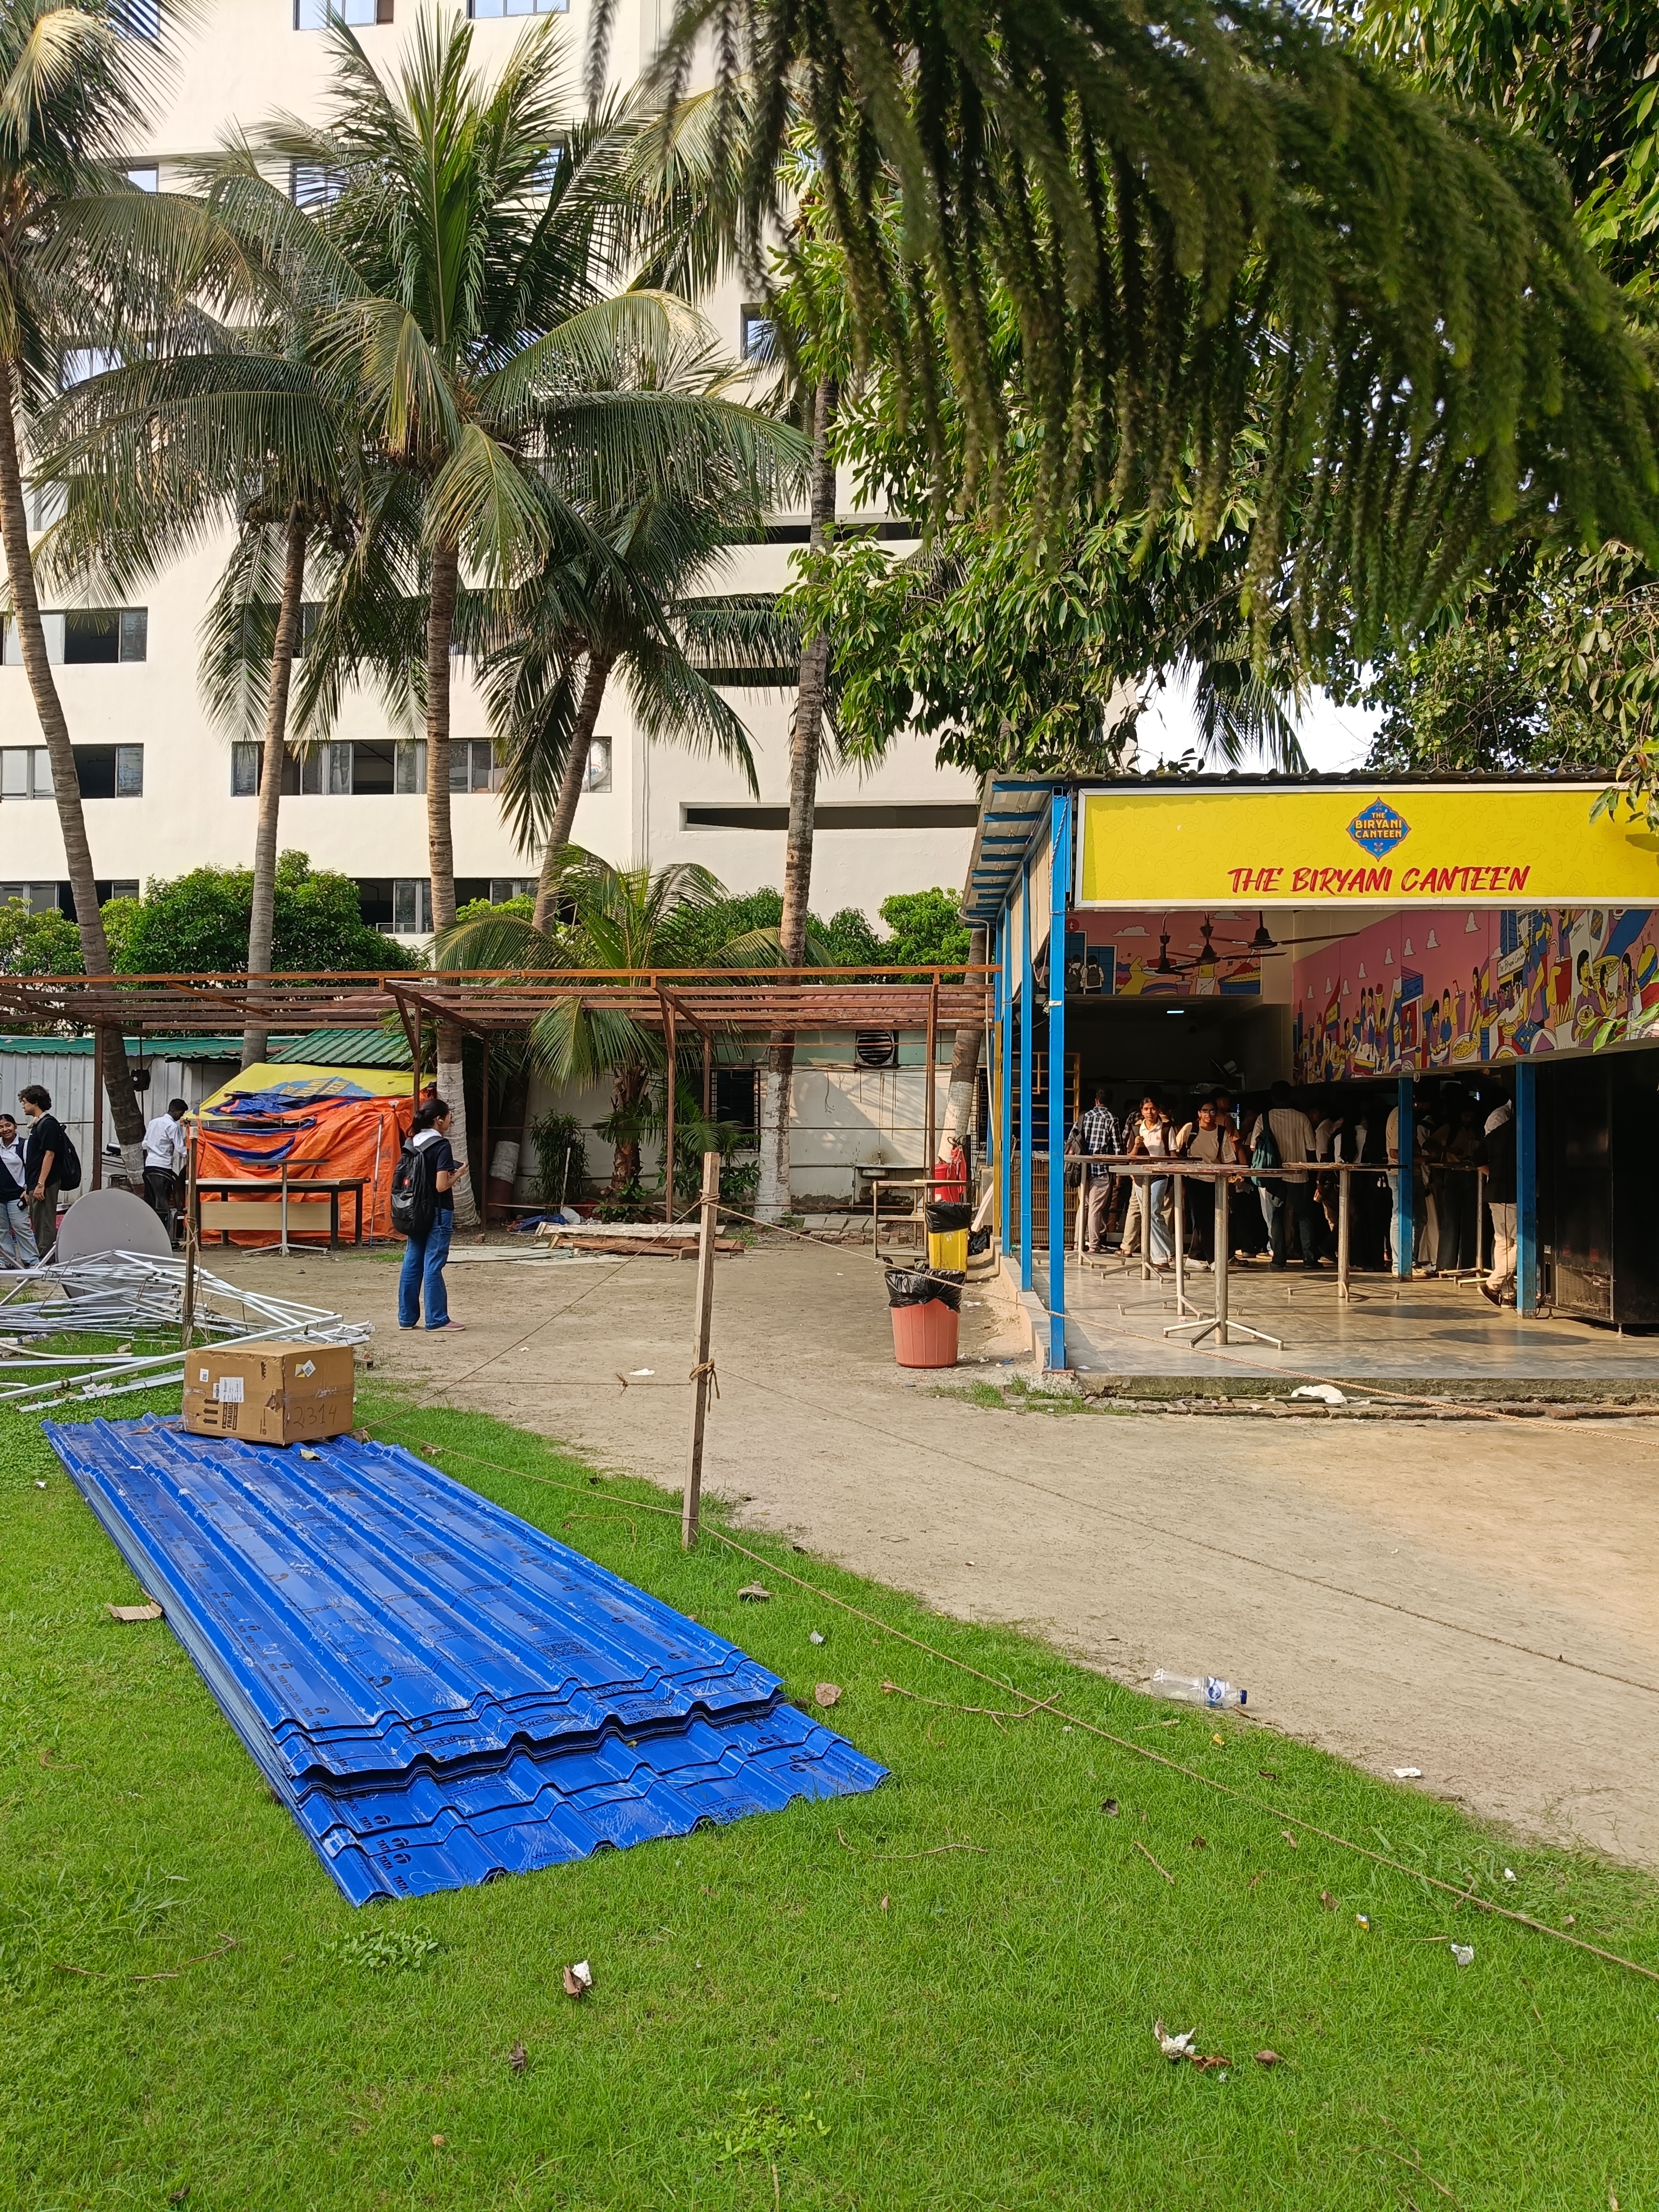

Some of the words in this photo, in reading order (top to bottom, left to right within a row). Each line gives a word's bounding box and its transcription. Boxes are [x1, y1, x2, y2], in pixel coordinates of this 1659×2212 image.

[1354, 820, 1402, 829] BIRYANI
[1354, 830, 1402, 839] CANTEEN
[1228, 867, 1283, 893] THE
[1290, 867, 1393, 895] BIRYANI
[1400, 865, 1531, 893] CANTEEN
[279, 1085, 299, 1095] THE
[293, 1404, 338, 1428] 2314
[267, 1663, 279, 1672] TATA
[277, 1675, 288, 1685] TATA
[301, 1707, 315, 1718] TATA
[769, 1733, 787, 1744] TATA
[359, 1816, 374, 1830] TATA
[376, 1839, 392, 1852] TATA
[531, 1848, 577, 1860] Warning
[377, 1855, 394, 1871] TATA
[392, 1875, 410, 1892] TATA
